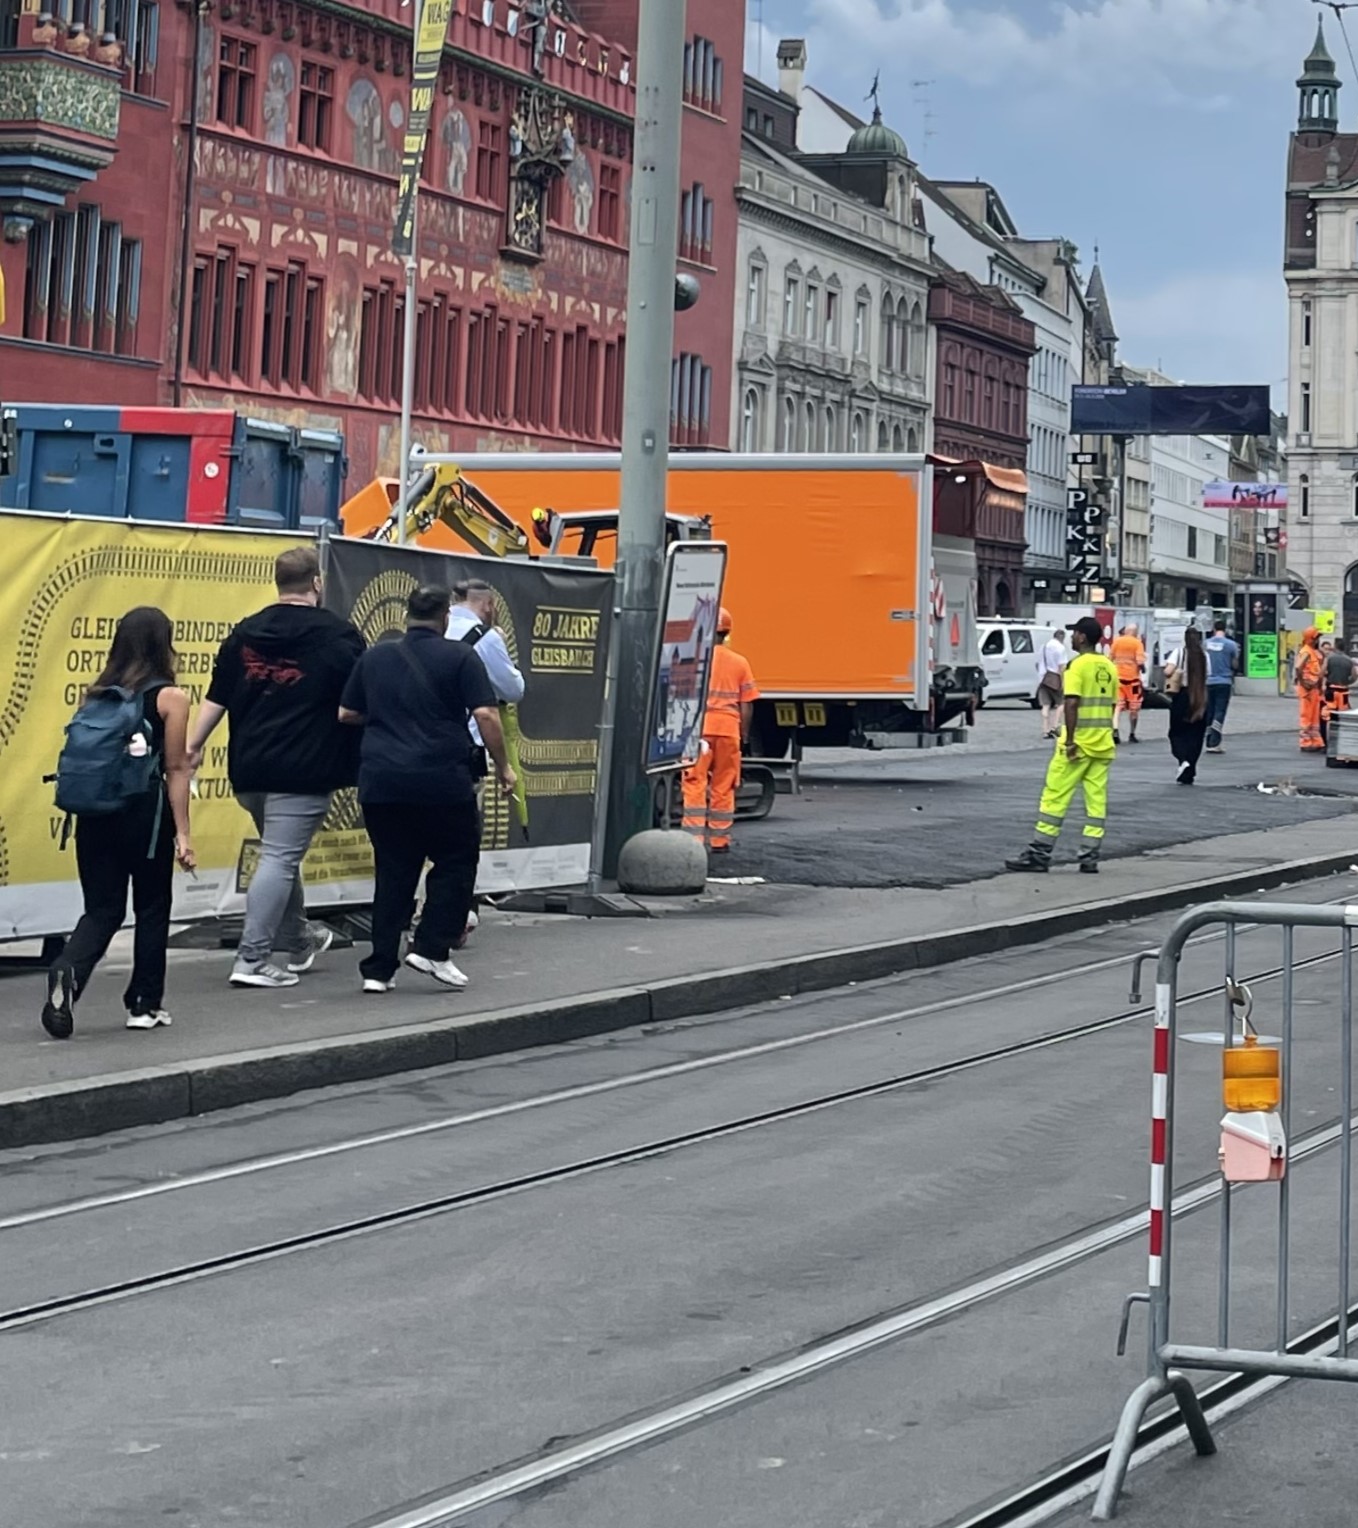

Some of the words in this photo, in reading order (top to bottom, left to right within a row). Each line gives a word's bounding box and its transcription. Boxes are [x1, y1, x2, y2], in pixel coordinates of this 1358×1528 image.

[71, 616, 121, 640] GLEI
[172, 621, 236, 643] BINDE
[533, 612, 552, 637] 80
[552, 614, 600, 640] JAHRE
[67, 650, 106, 673] ORT
